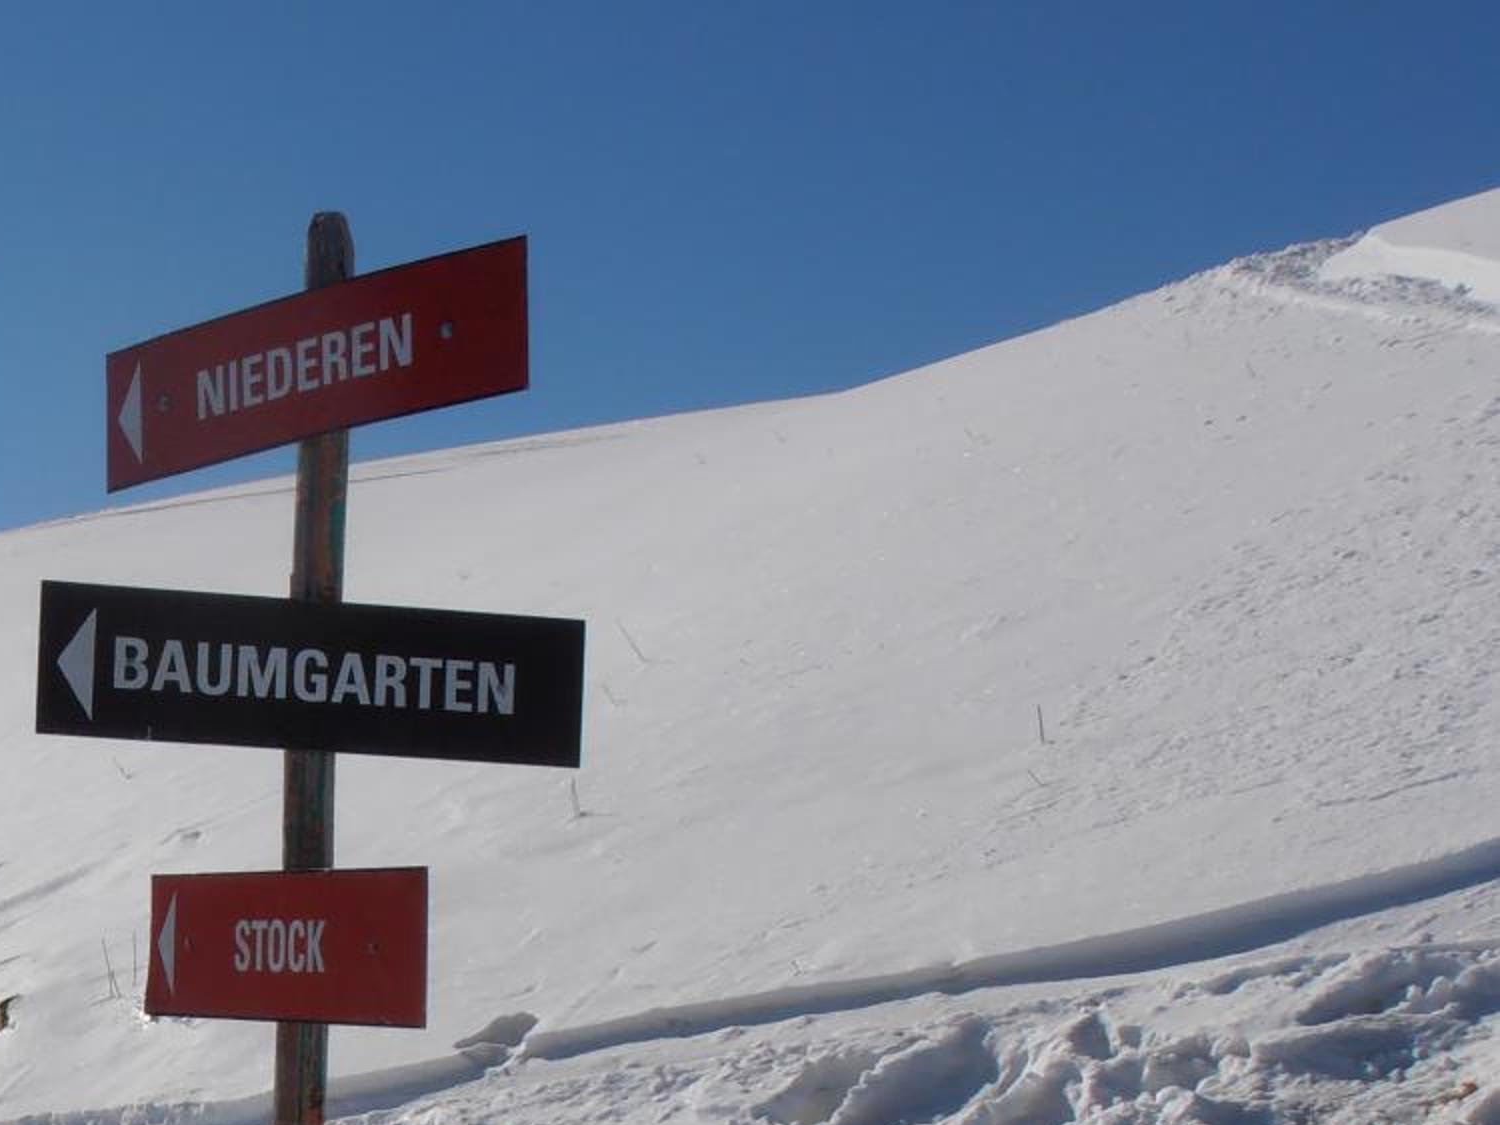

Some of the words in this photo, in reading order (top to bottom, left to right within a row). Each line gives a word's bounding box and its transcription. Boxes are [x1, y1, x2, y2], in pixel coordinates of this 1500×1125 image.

[196, 313, 413, 420] NIEDEREN
[113, 635, 516, 715] BAUMGARTEN
[233, 919, 326, 974] STOCK
